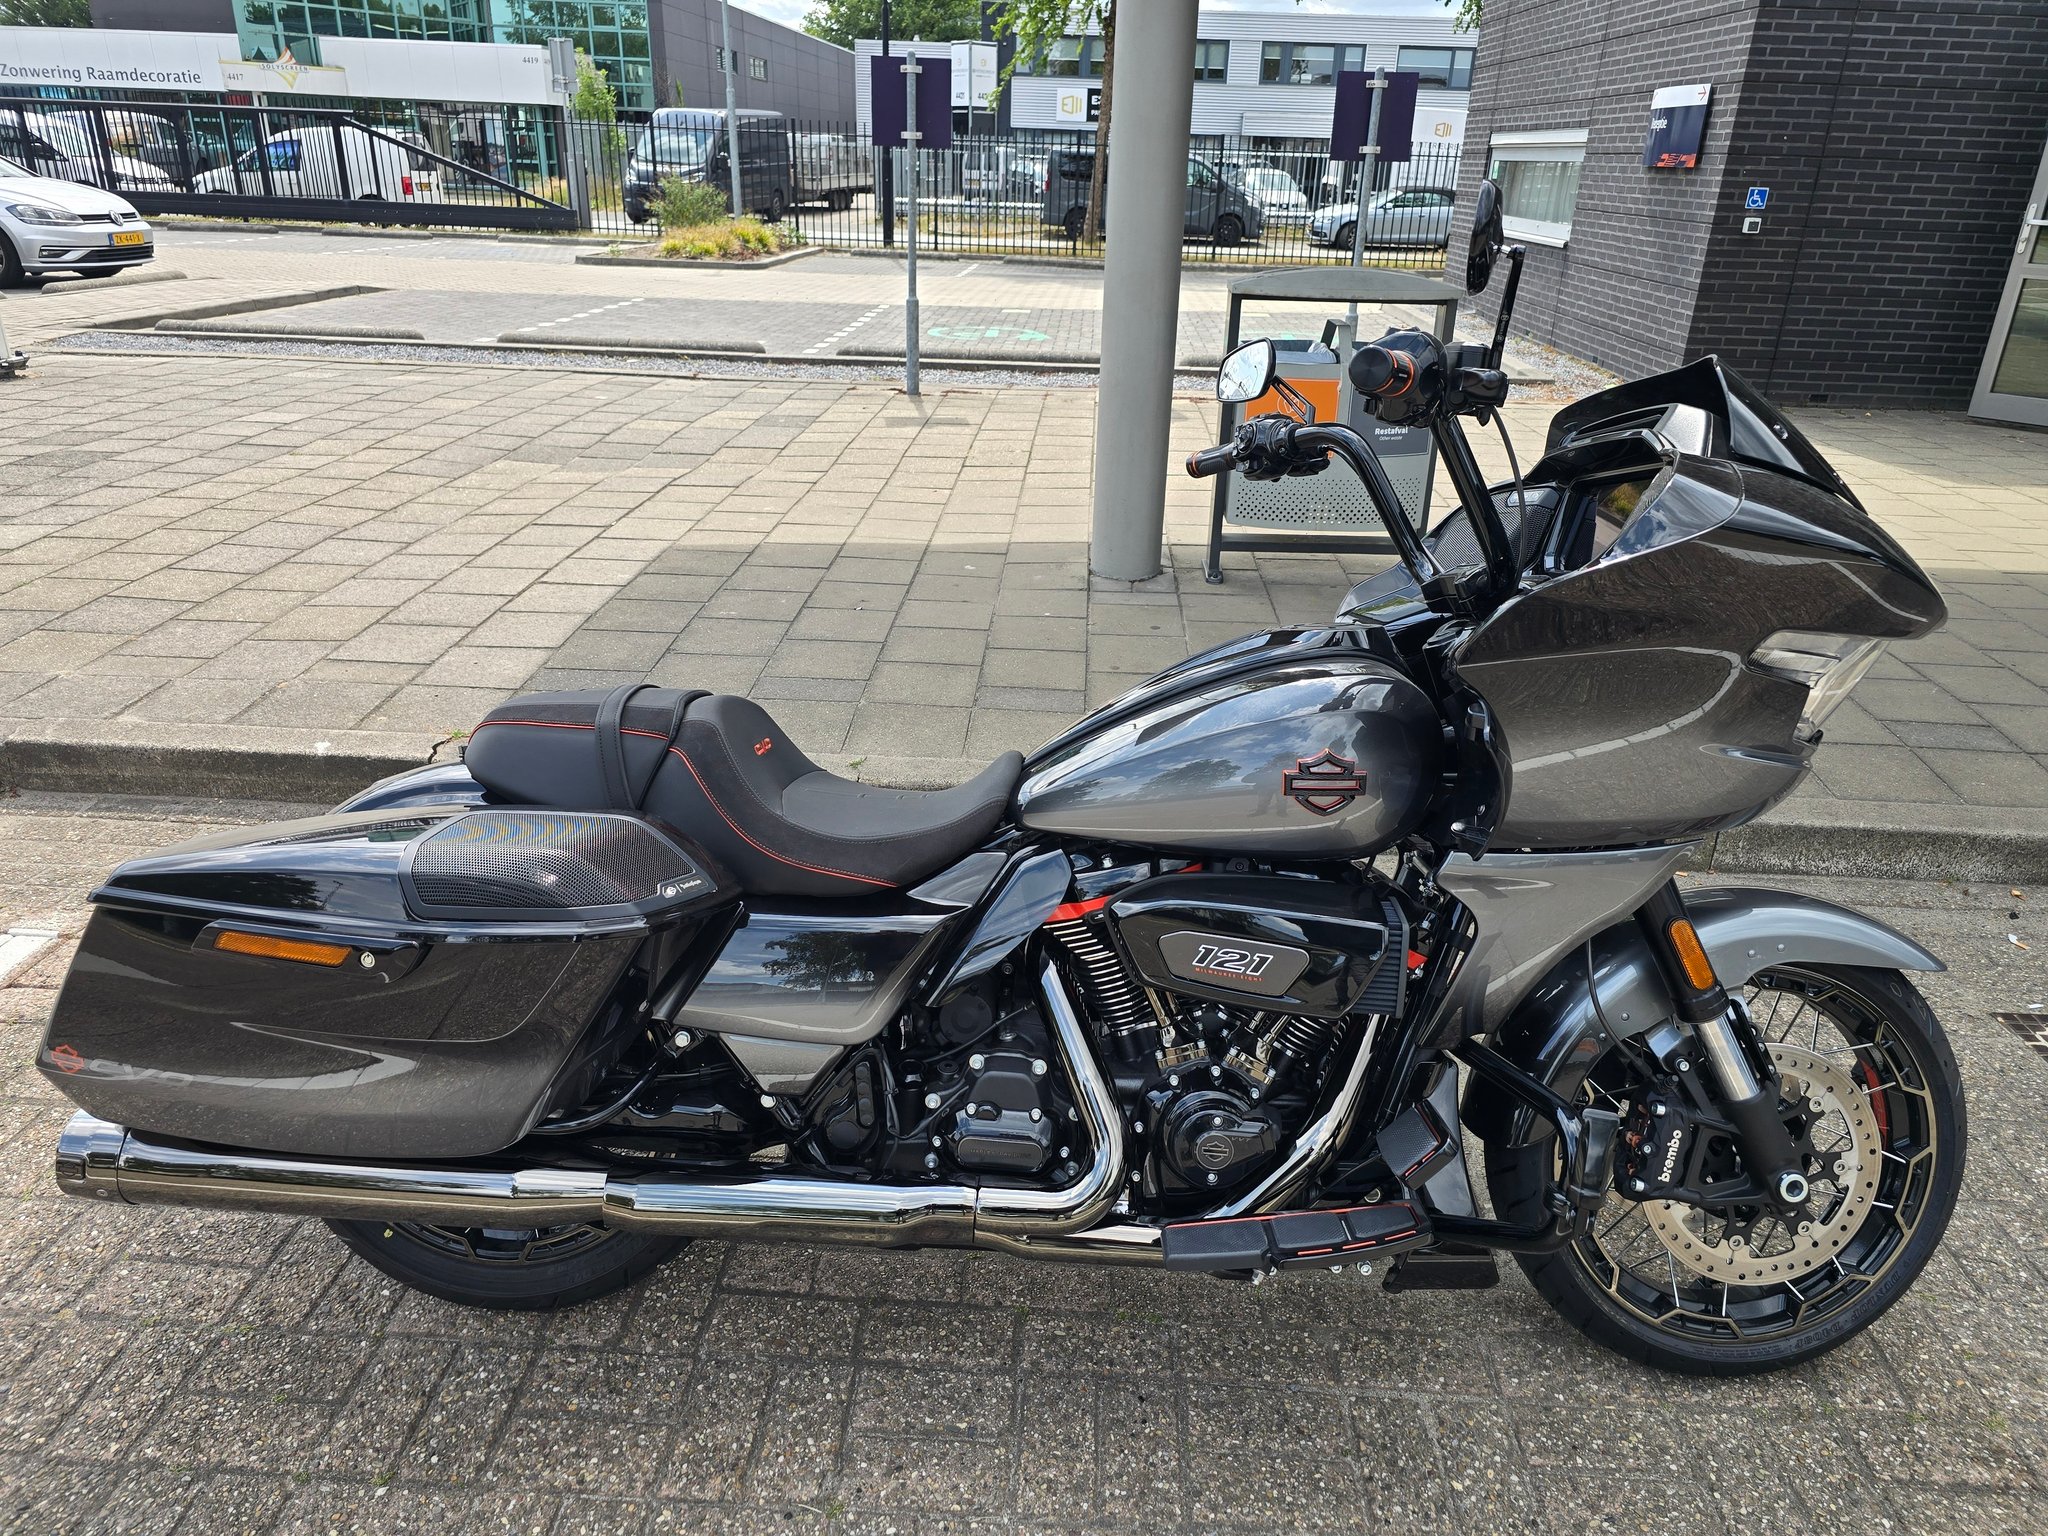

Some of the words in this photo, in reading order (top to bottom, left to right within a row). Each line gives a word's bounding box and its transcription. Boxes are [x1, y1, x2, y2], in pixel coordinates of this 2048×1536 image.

[522, 56, 539, 64] 4419
[261, 63, 308, 72] SOLYSCREEN
[0, 63, 82, 82] Zonwering
[86, 66, 202, 84] Raamdecoratie
[227, 73, 244, 81] 4417
[1374, 425, 1408, 435] Restafval
[1192, 944, 1274, 976] 121
[1657, 1129, 1682, 1183] brembo
